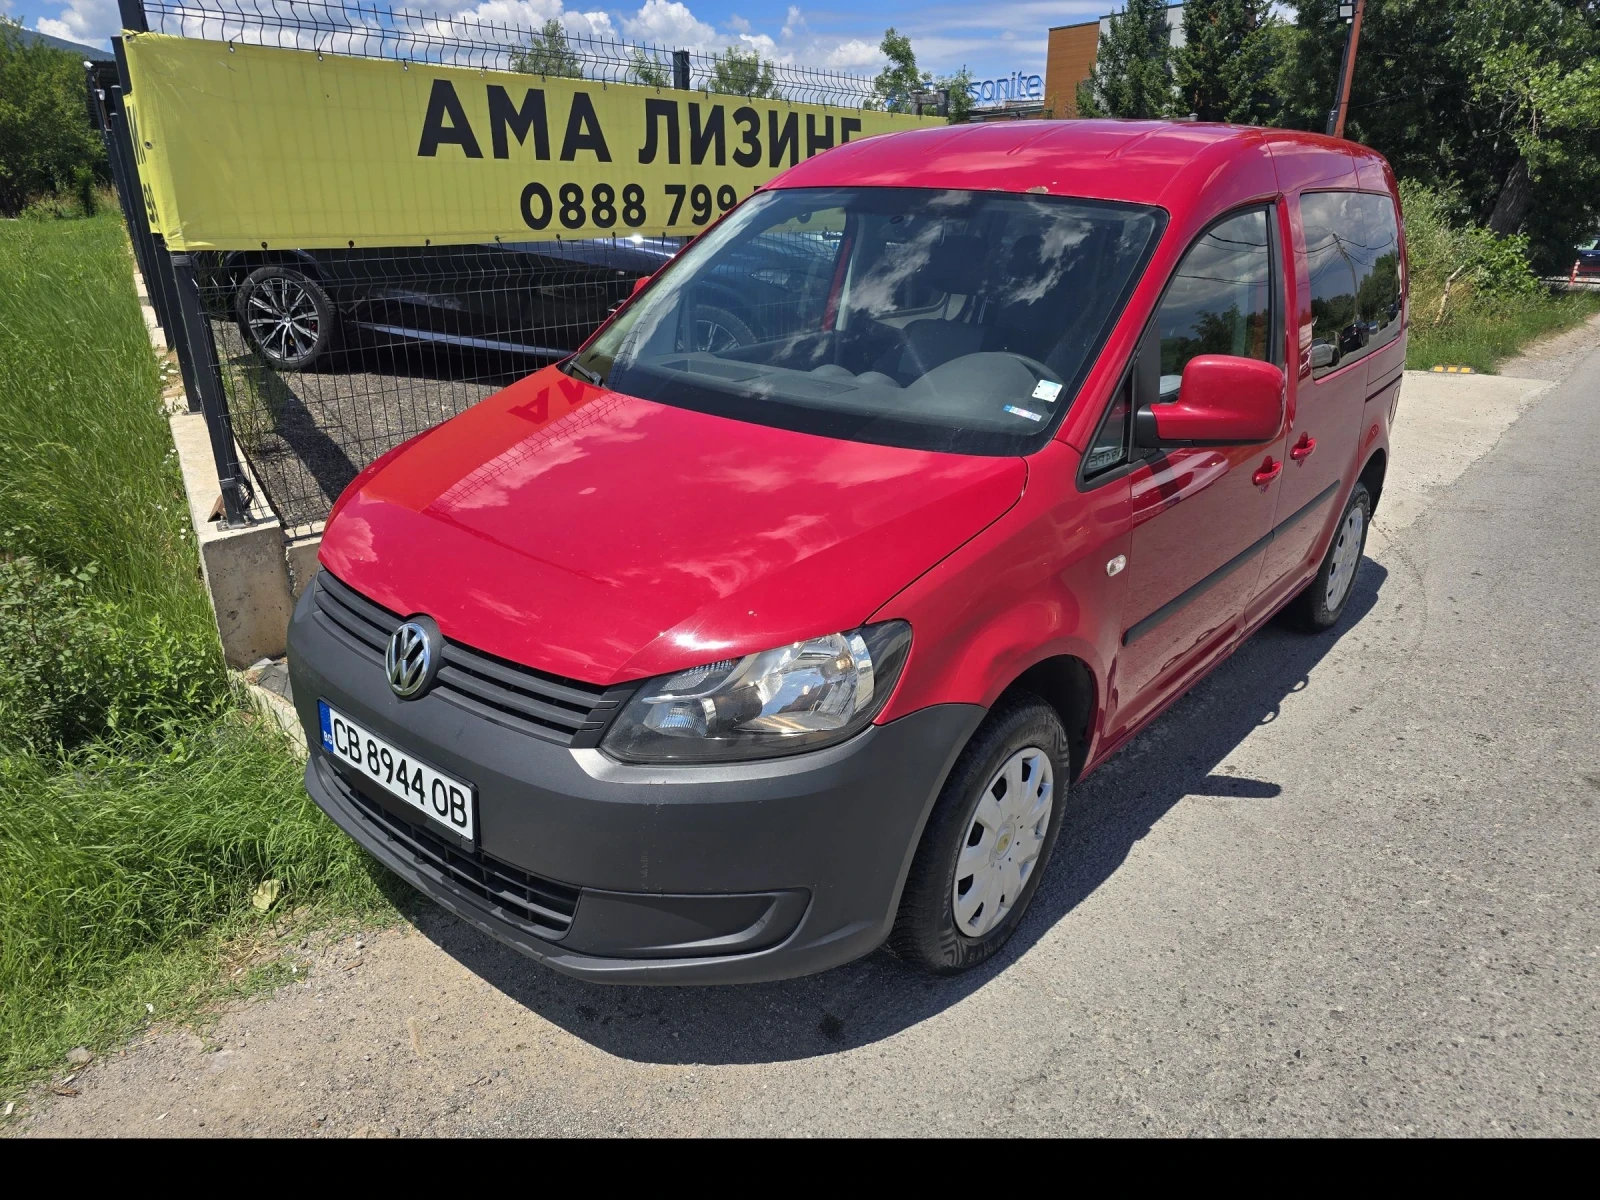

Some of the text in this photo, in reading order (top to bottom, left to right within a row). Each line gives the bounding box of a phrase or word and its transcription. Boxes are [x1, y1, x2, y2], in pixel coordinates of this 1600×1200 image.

[418, 79, 612, 163] АМА
[520, 182, 738, 230] 0888 799
[367, 739, 426, 806] 8944
